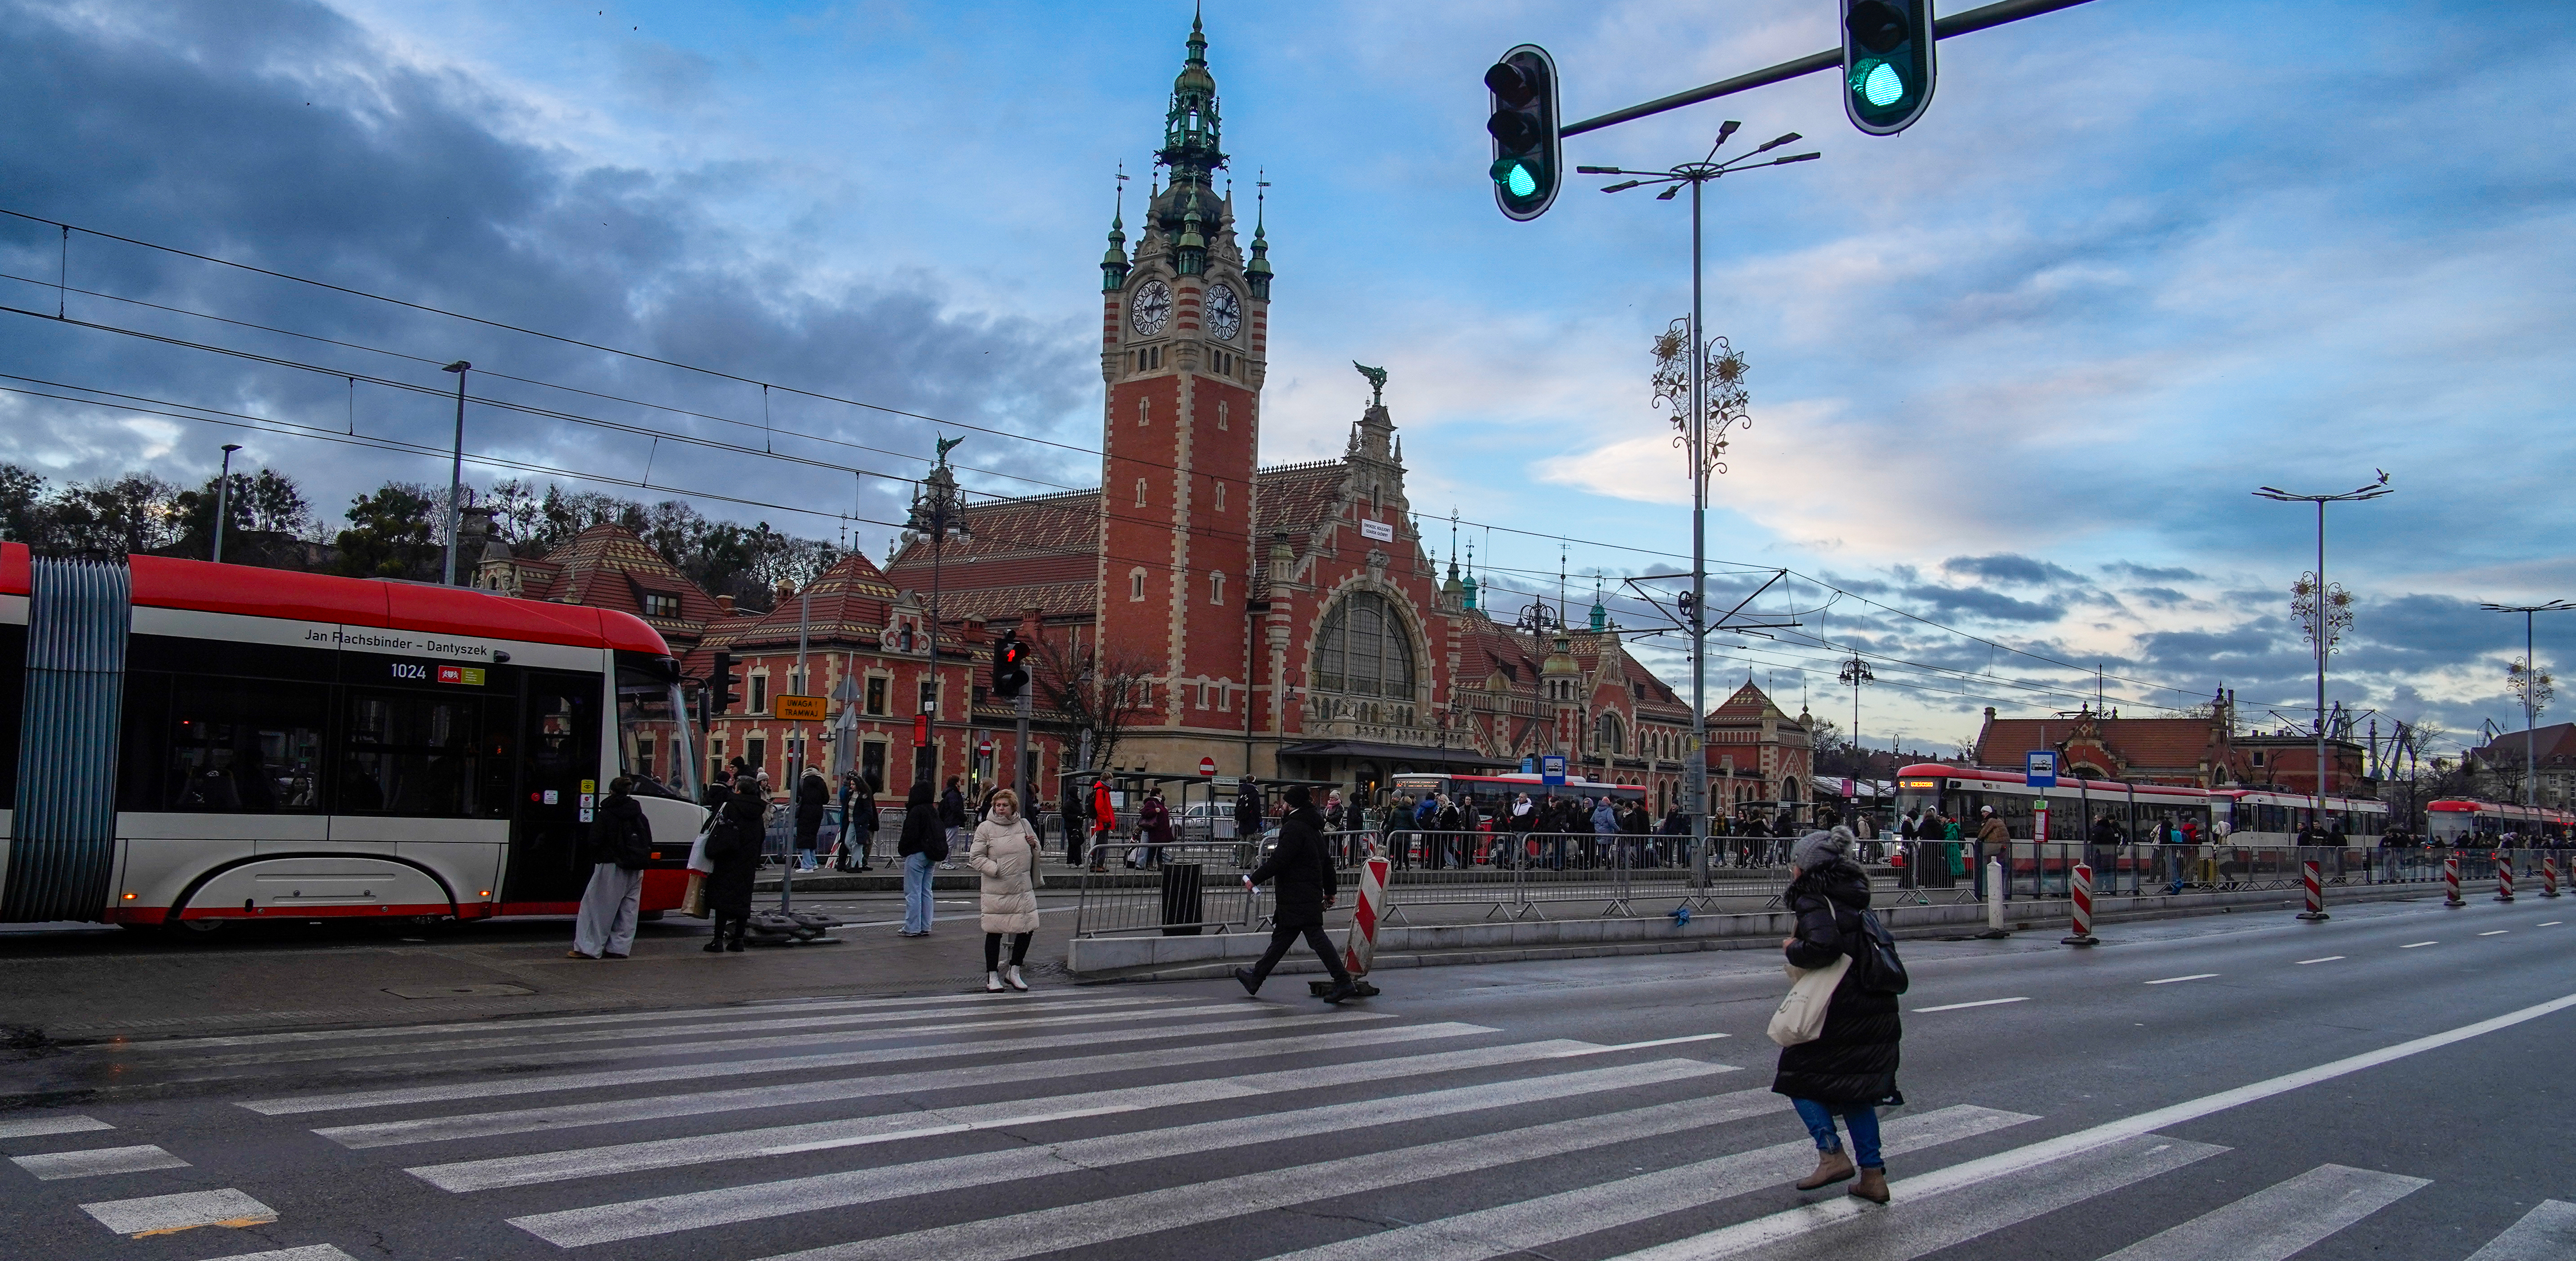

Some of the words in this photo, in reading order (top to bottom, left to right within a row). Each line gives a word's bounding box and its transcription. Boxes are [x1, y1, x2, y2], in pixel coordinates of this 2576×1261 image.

[305, 629, 327, 642] Jan
[332, 631, 413, 649] Flachsbinder
[427, 640, 487, 656] Dantyszek
[392, 663, 426, 679] 1024
[787, 699, 812, 707] UWAGA
[785, 709, 818, 717] TRAMWAJ
